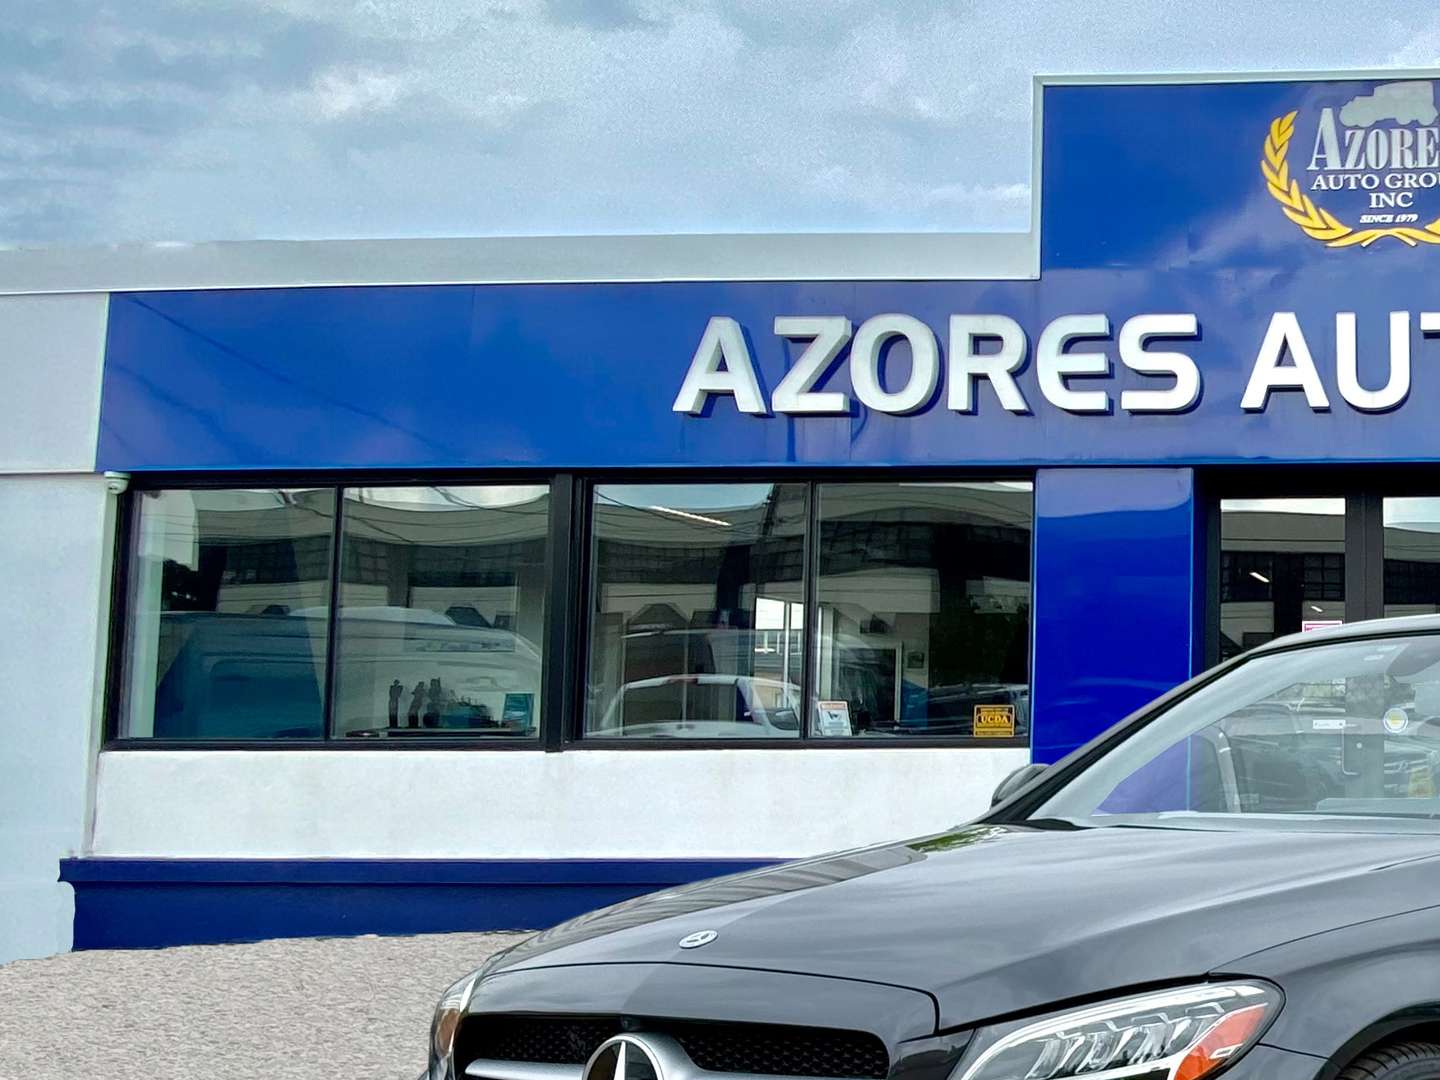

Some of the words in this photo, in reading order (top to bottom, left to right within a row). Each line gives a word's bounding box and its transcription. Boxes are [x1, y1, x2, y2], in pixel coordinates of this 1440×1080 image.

[1311, 173, 1379, 191] AUTO
[1369, 191, 1414, 209] INC
[1360, 214, 1394, 223] SINCE
[1395, 213, 1418, 223] 1979
[672, 313, 1202, 415] AZORES
[981, 715, 1008, 724] UCDA
